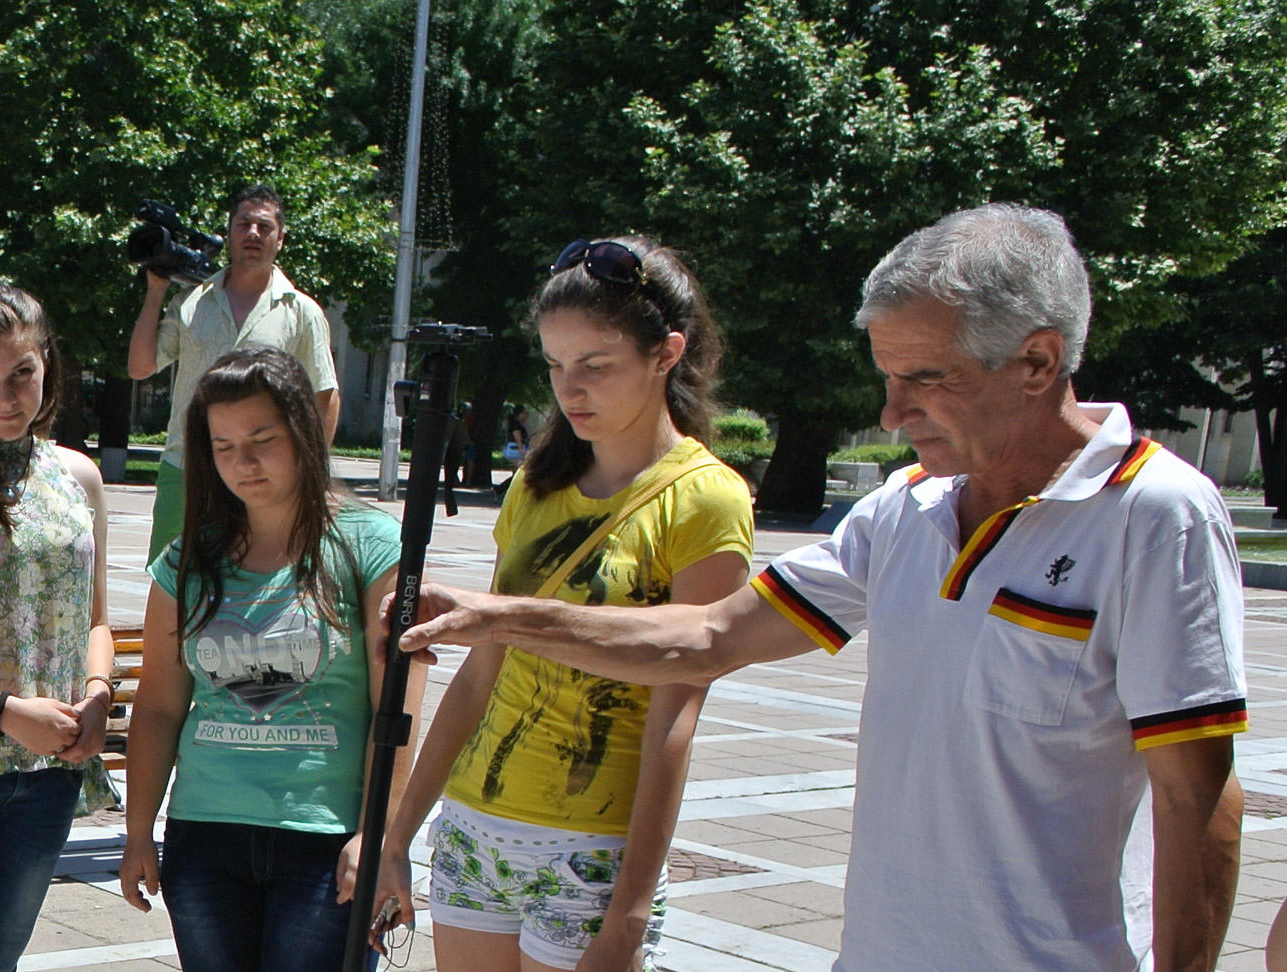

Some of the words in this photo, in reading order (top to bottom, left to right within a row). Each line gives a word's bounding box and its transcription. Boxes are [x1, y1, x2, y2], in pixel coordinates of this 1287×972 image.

[400, 575, 418, 626] BENRO
[197, 647, 220, 661] TEA
[199, 724, 224, 739] FOR
[228, 726, 260, 742] YOU
[265, 728, 301, 742] AND
[306, 729, 331, 743] ME
